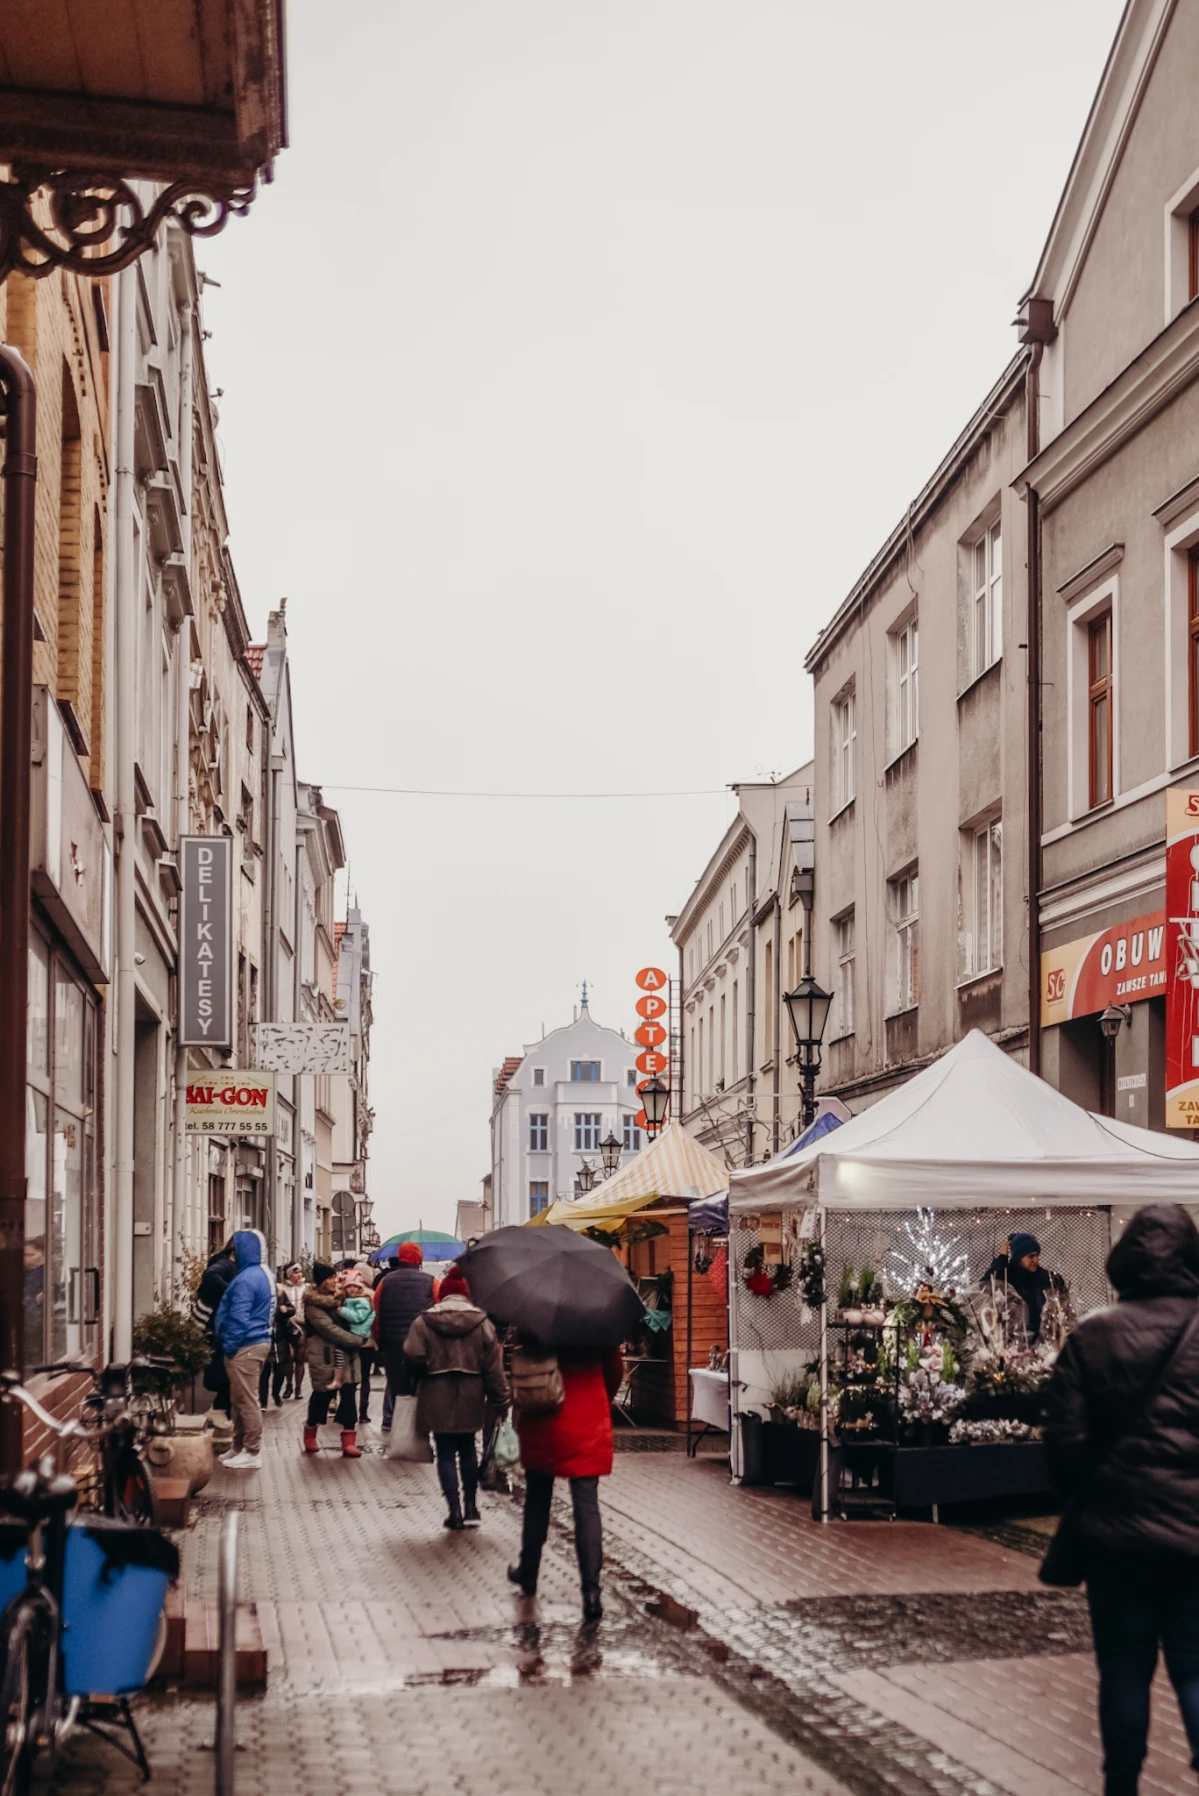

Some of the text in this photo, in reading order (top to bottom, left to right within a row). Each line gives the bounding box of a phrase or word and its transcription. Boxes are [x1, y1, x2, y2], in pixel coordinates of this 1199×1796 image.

[197, 847, 213, 1035] DELIKATESY
[1100, 924, 1165, 976] OBUW
[1116, 975, 1147, 996] ZAWSZE
[643, 970, 660, 1127] APTE
[189, 1106, 265, 1115] Kuchnia Orientalna
[202, 1122, 215, 1130] 58
[218, 1122, 236, 1130] 777
[239, 1122, 252, 1131] 55
[255, 1122, 268, 1131] 55
